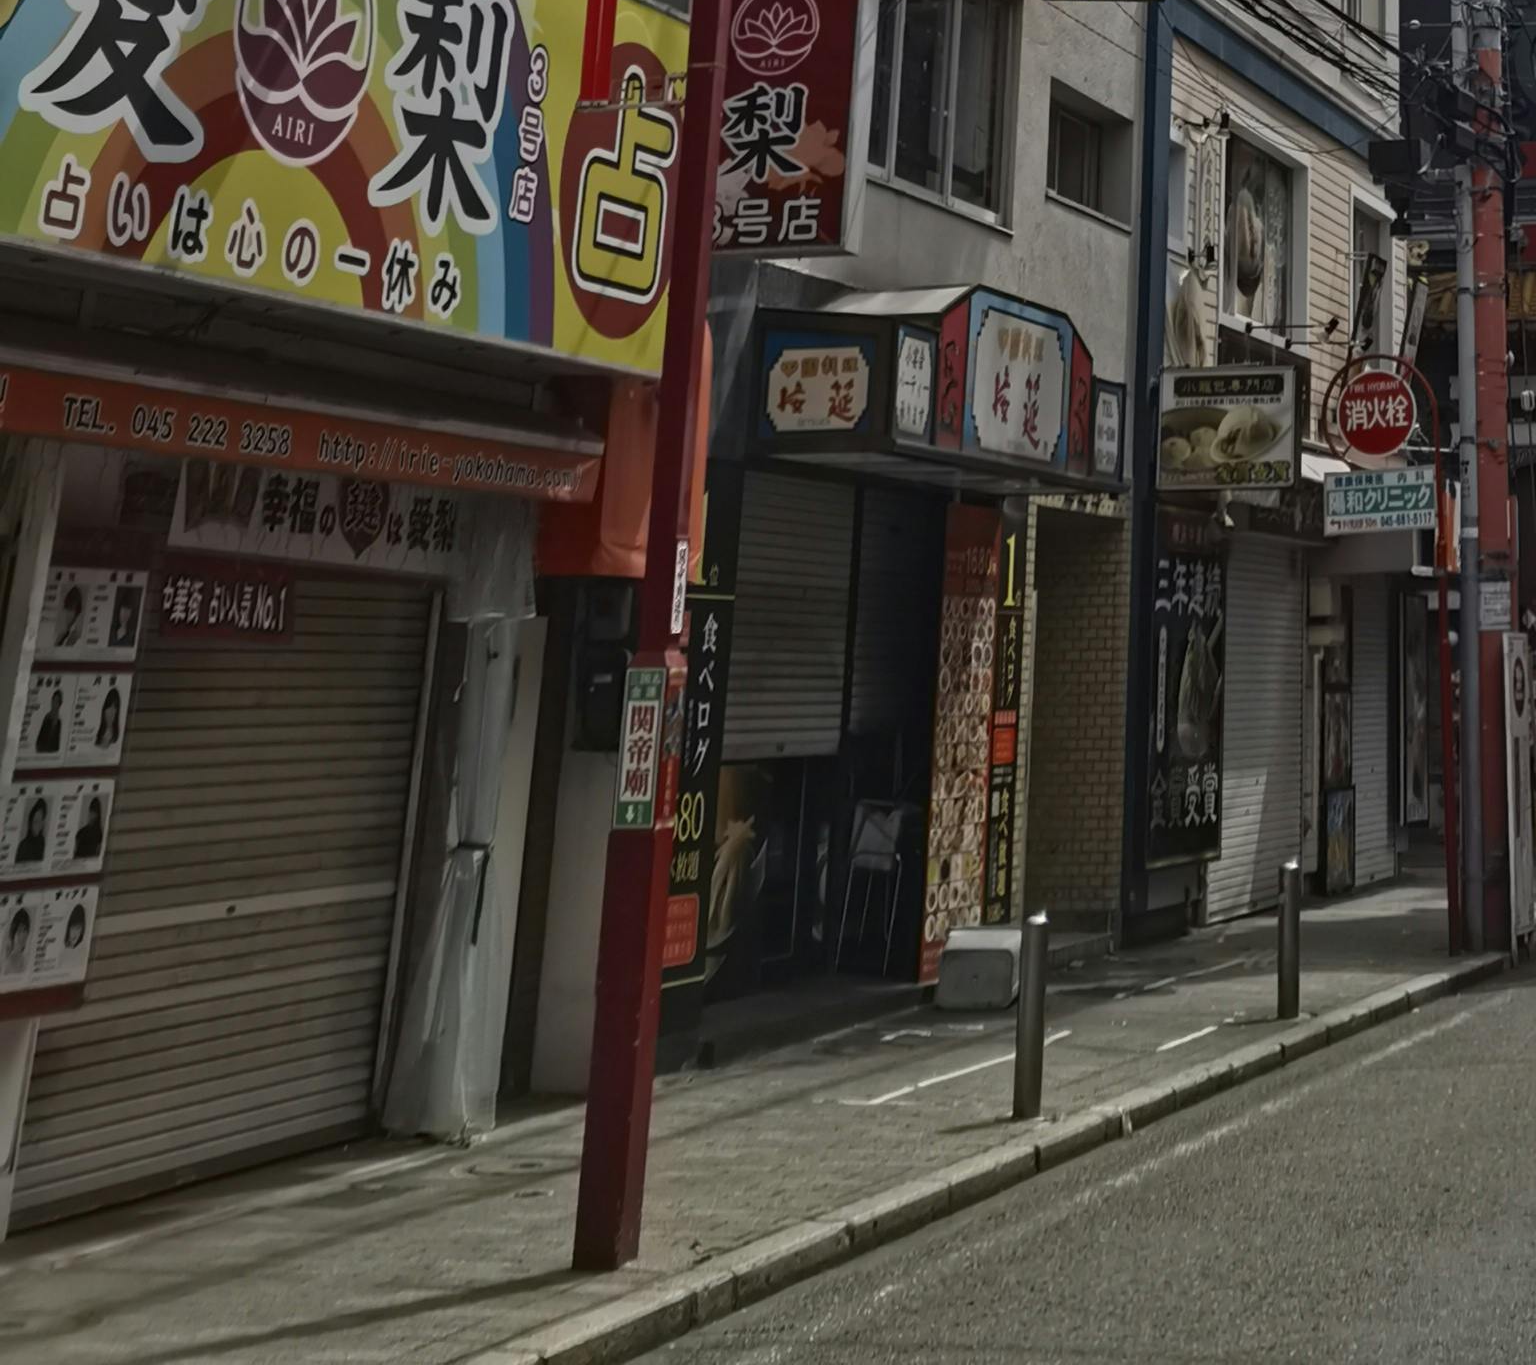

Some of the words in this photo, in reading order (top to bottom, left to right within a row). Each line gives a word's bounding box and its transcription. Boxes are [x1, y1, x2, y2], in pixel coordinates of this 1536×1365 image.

[271, 112, 317, 147] AIRI
[508, 44, 550, 225] 3号店
[720, 83, 809, 183] 梨
[571, 66, 678, 306] 占
[41, 154, 463, 319] 占いは心の一休み
[61, 393, 117, 433] TEL.
[131, 404, 176, 442] 045
[187, 415, 229, 449] 222
[239, 421, 292, 457] 3258
[1345, 394, 1409, 432] 消火栓
[161, 574, 204, 624] 中華街
[207, 582, 288, 632] 占い人気No.1
[691, 612, 720, 778] 食べログ
[622, 704, 656, 798] 関帝廟
